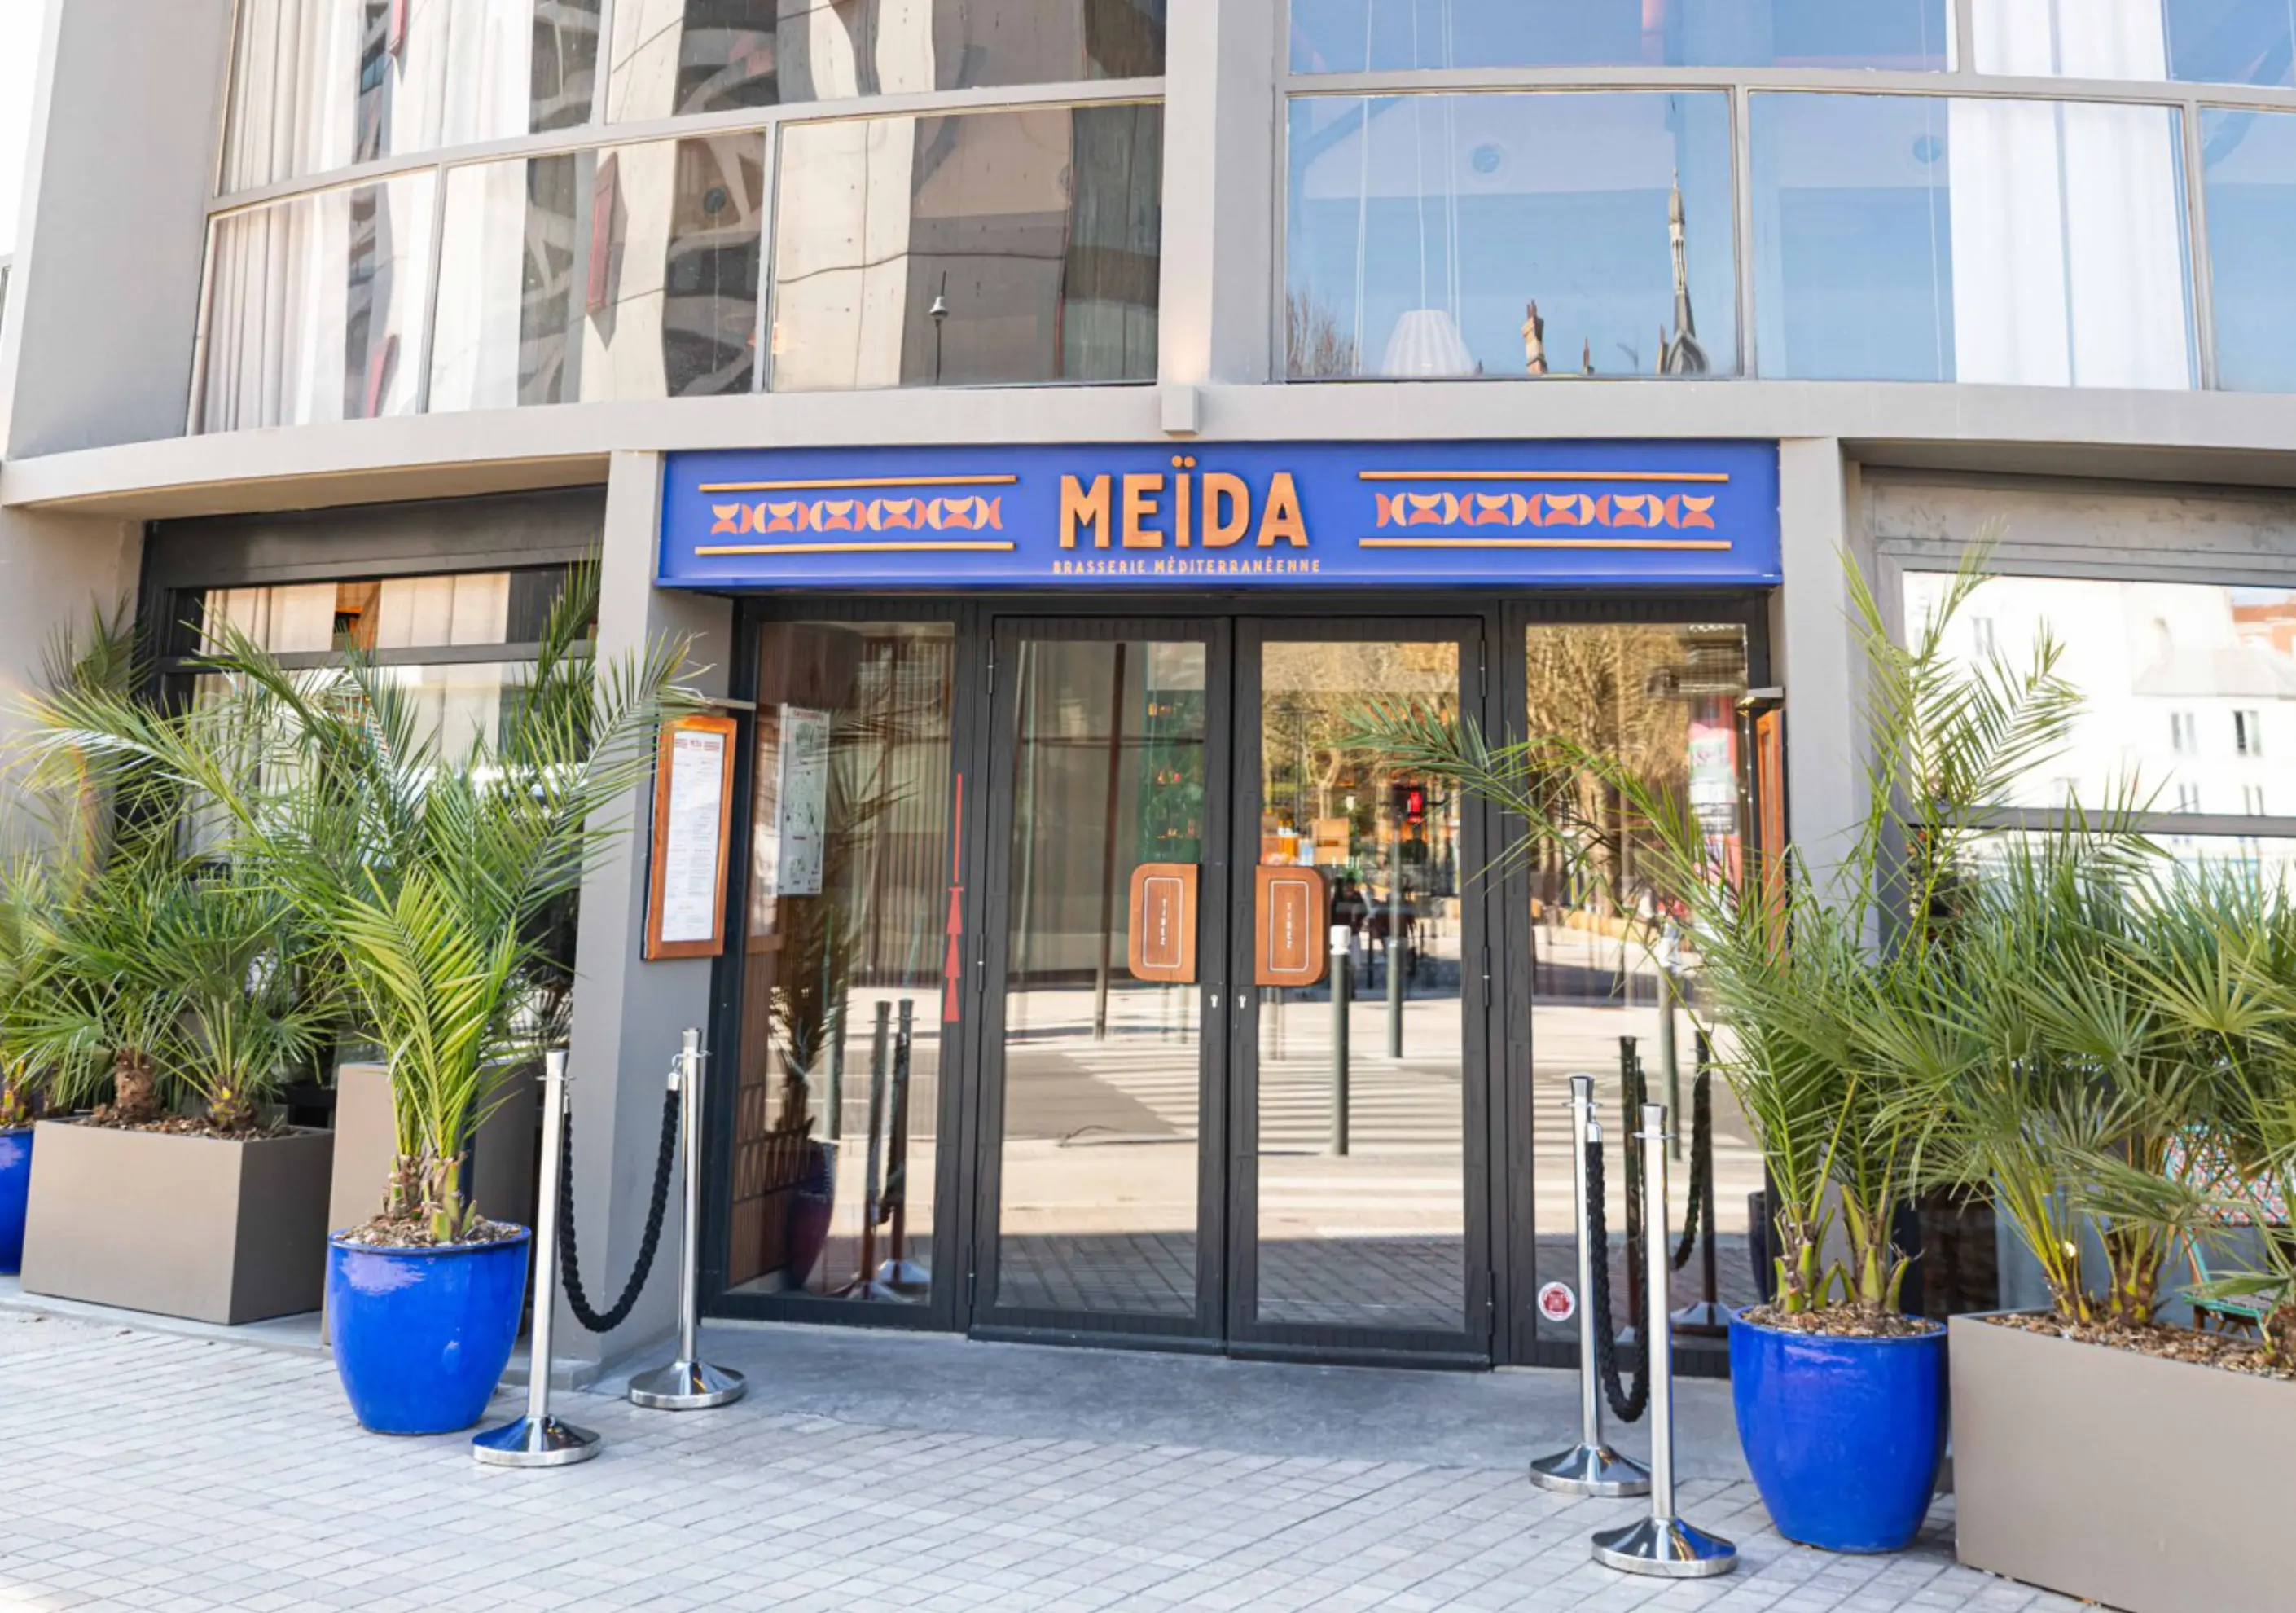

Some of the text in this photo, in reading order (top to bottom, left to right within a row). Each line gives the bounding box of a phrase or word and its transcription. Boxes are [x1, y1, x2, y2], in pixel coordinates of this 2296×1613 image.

[1059, 455, 1309, 548] MEÏDA
[1053, 555, 1320, 574] BRASSERIE MÉDITERRANÉENNE
